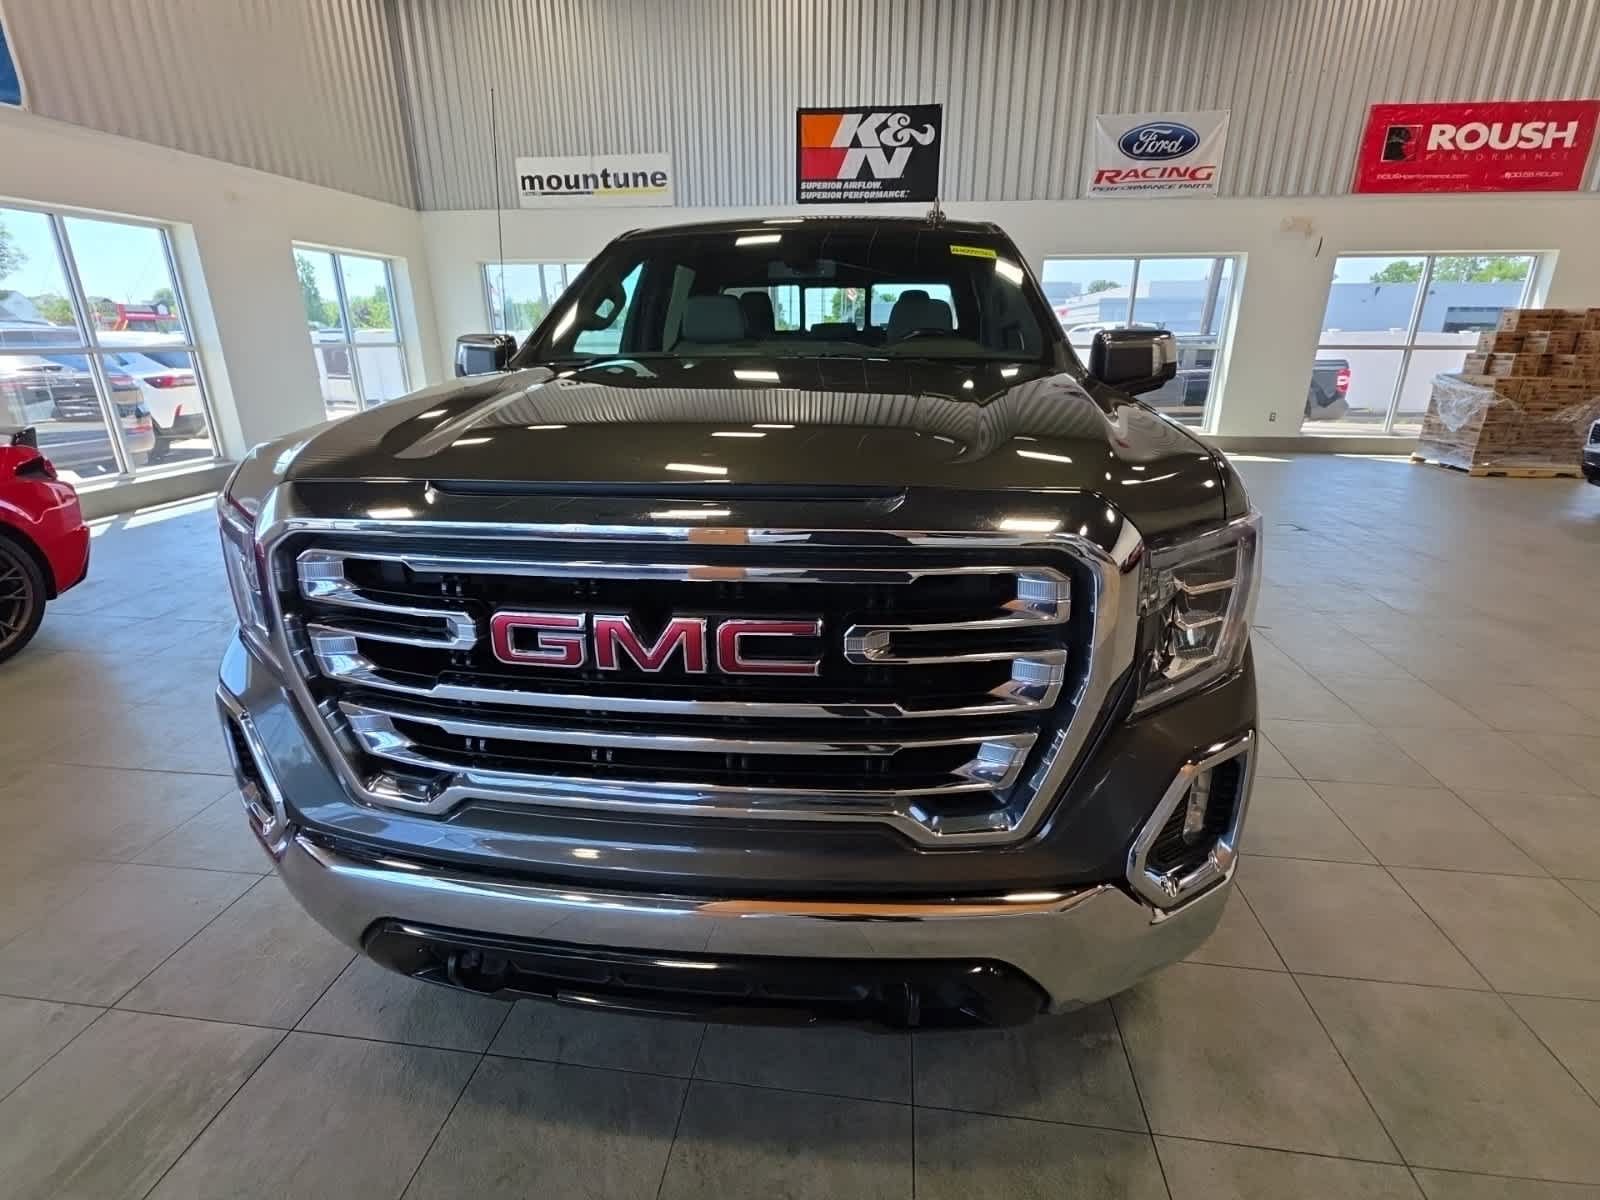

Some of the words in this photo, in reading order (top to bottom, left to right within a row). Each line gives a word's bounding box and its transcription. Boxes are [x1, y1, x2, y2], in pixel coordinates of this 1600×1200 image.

[1132, 128, 1184, 154] Ford
[1426, 121, 1579, 151] ROUSH
[521, 168, 668, 191] mountune
[800, 181, 842, 189] SUPERIOR
[1094, 165, 1217, 184] RACING
[800, 190, 842, 199] SUPERIOR
[1091, 183, 1176, 192] PERFORMANCE
[490, 610, 824, 676] GMC
